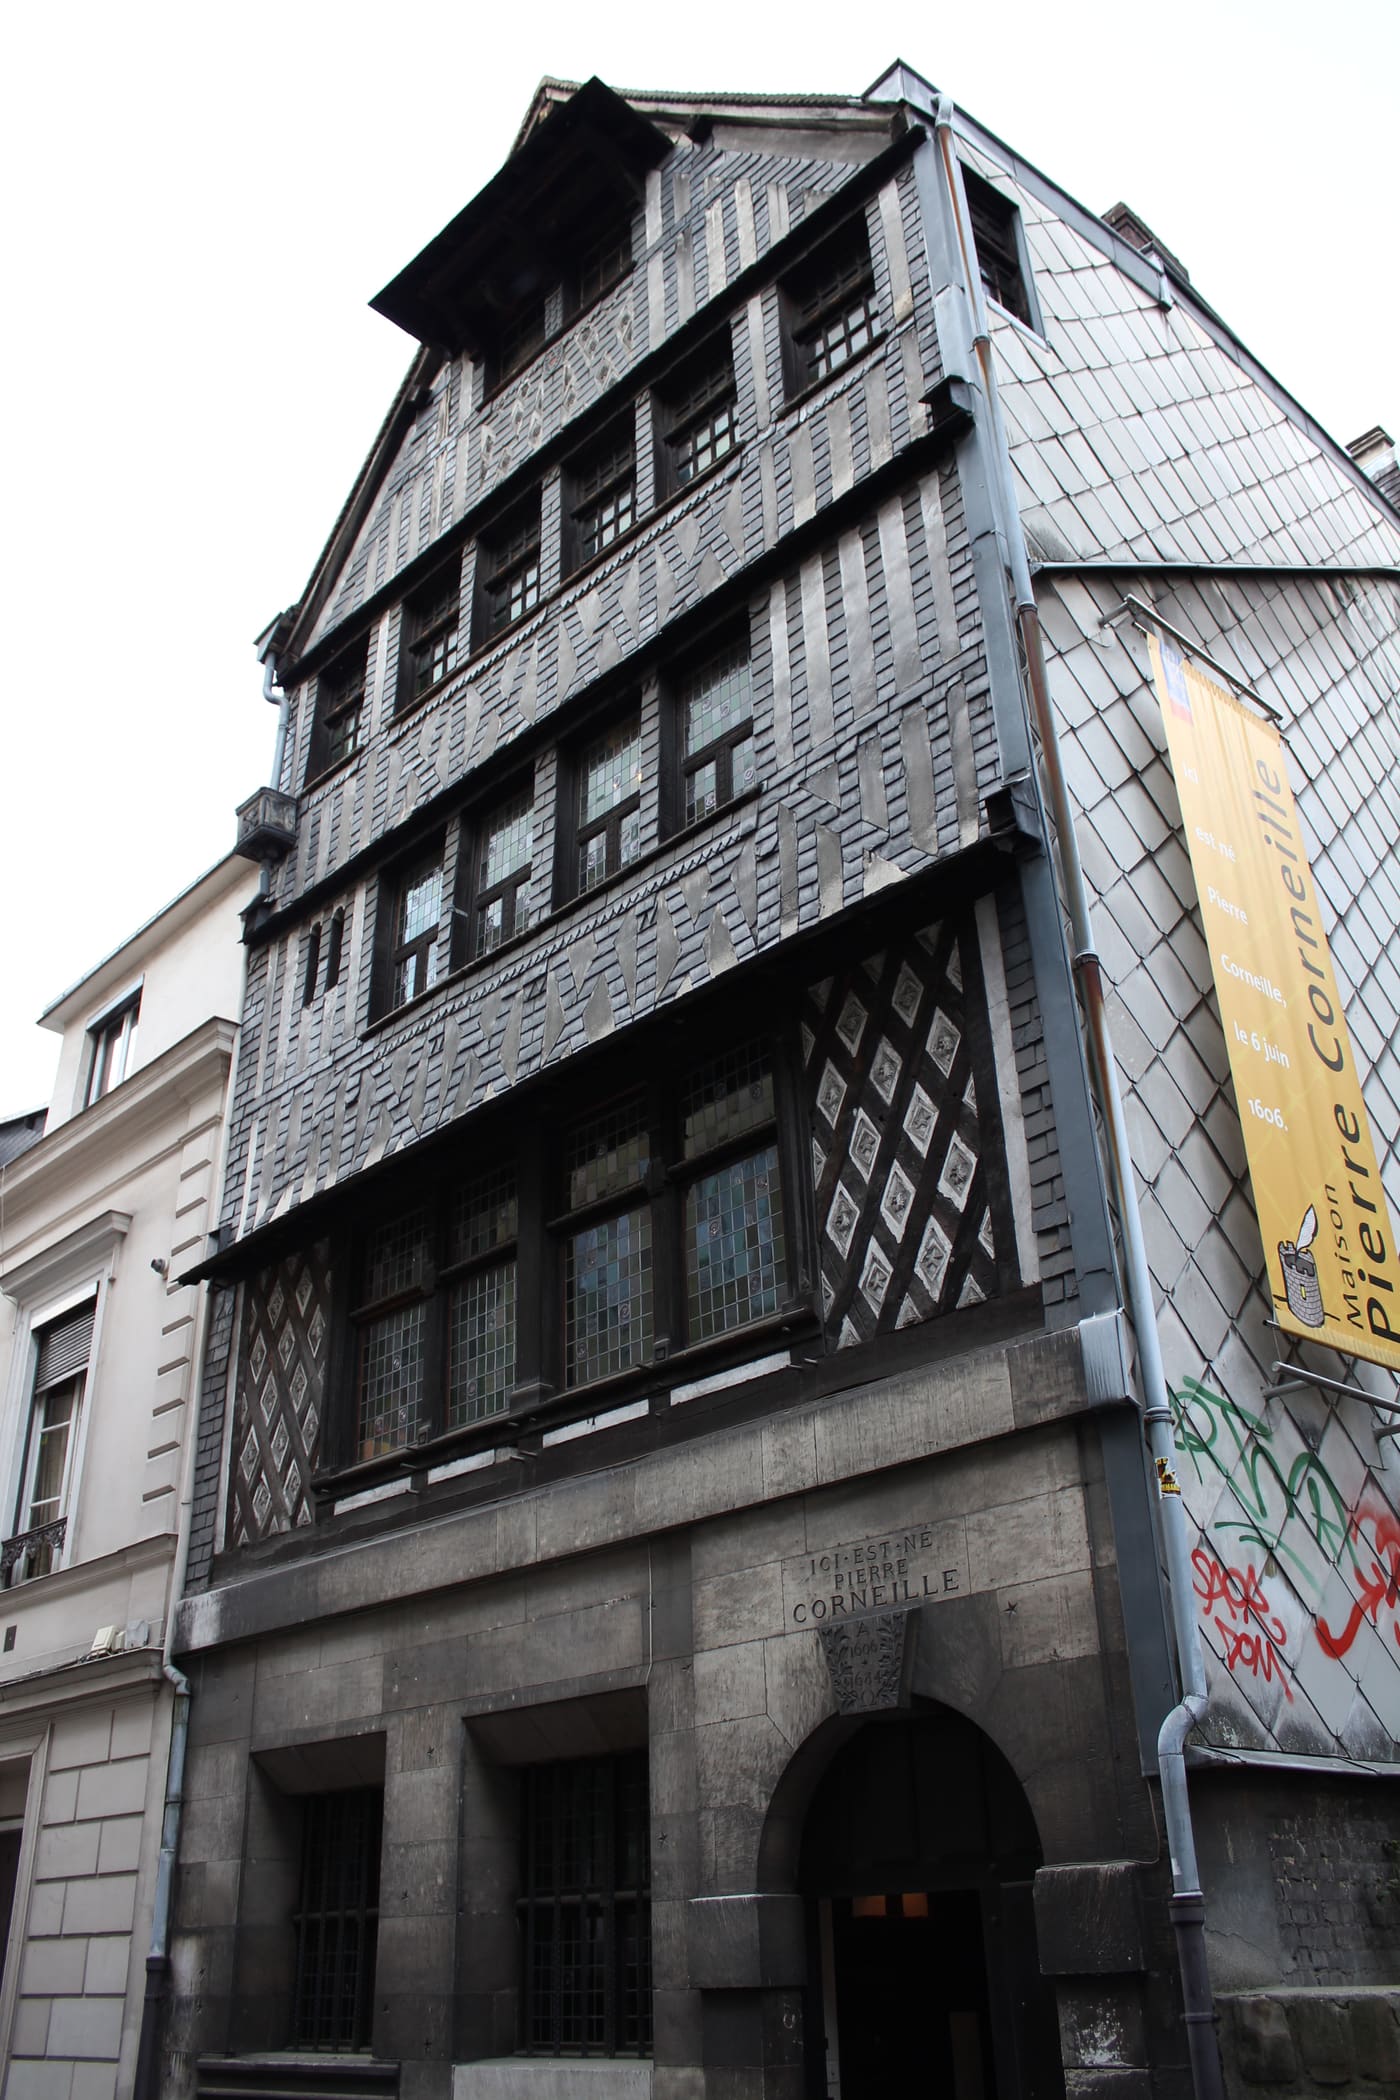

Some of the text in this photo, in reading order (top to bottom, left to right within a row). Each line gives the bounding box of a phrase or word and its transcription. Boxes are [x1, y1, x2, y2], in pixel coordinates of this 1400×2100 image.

[1194, 826, 1237, 863] est né
[1207, 886, 1249, 926] Pierre
[1220, 953, 1288, 1008] Corneille,
[1233, 1020, 1291, 1069] le 6 juin
[1249, 758, 1400, 1344] Pierre Corneille
[1247, 1098, 1289, 1132] 1606.
[1324, 1184, 1364, 1330] Maison
[792, 1568, 960, 1624] CORNEILLE
[834, 1558, 909, 1591] PIERRE
